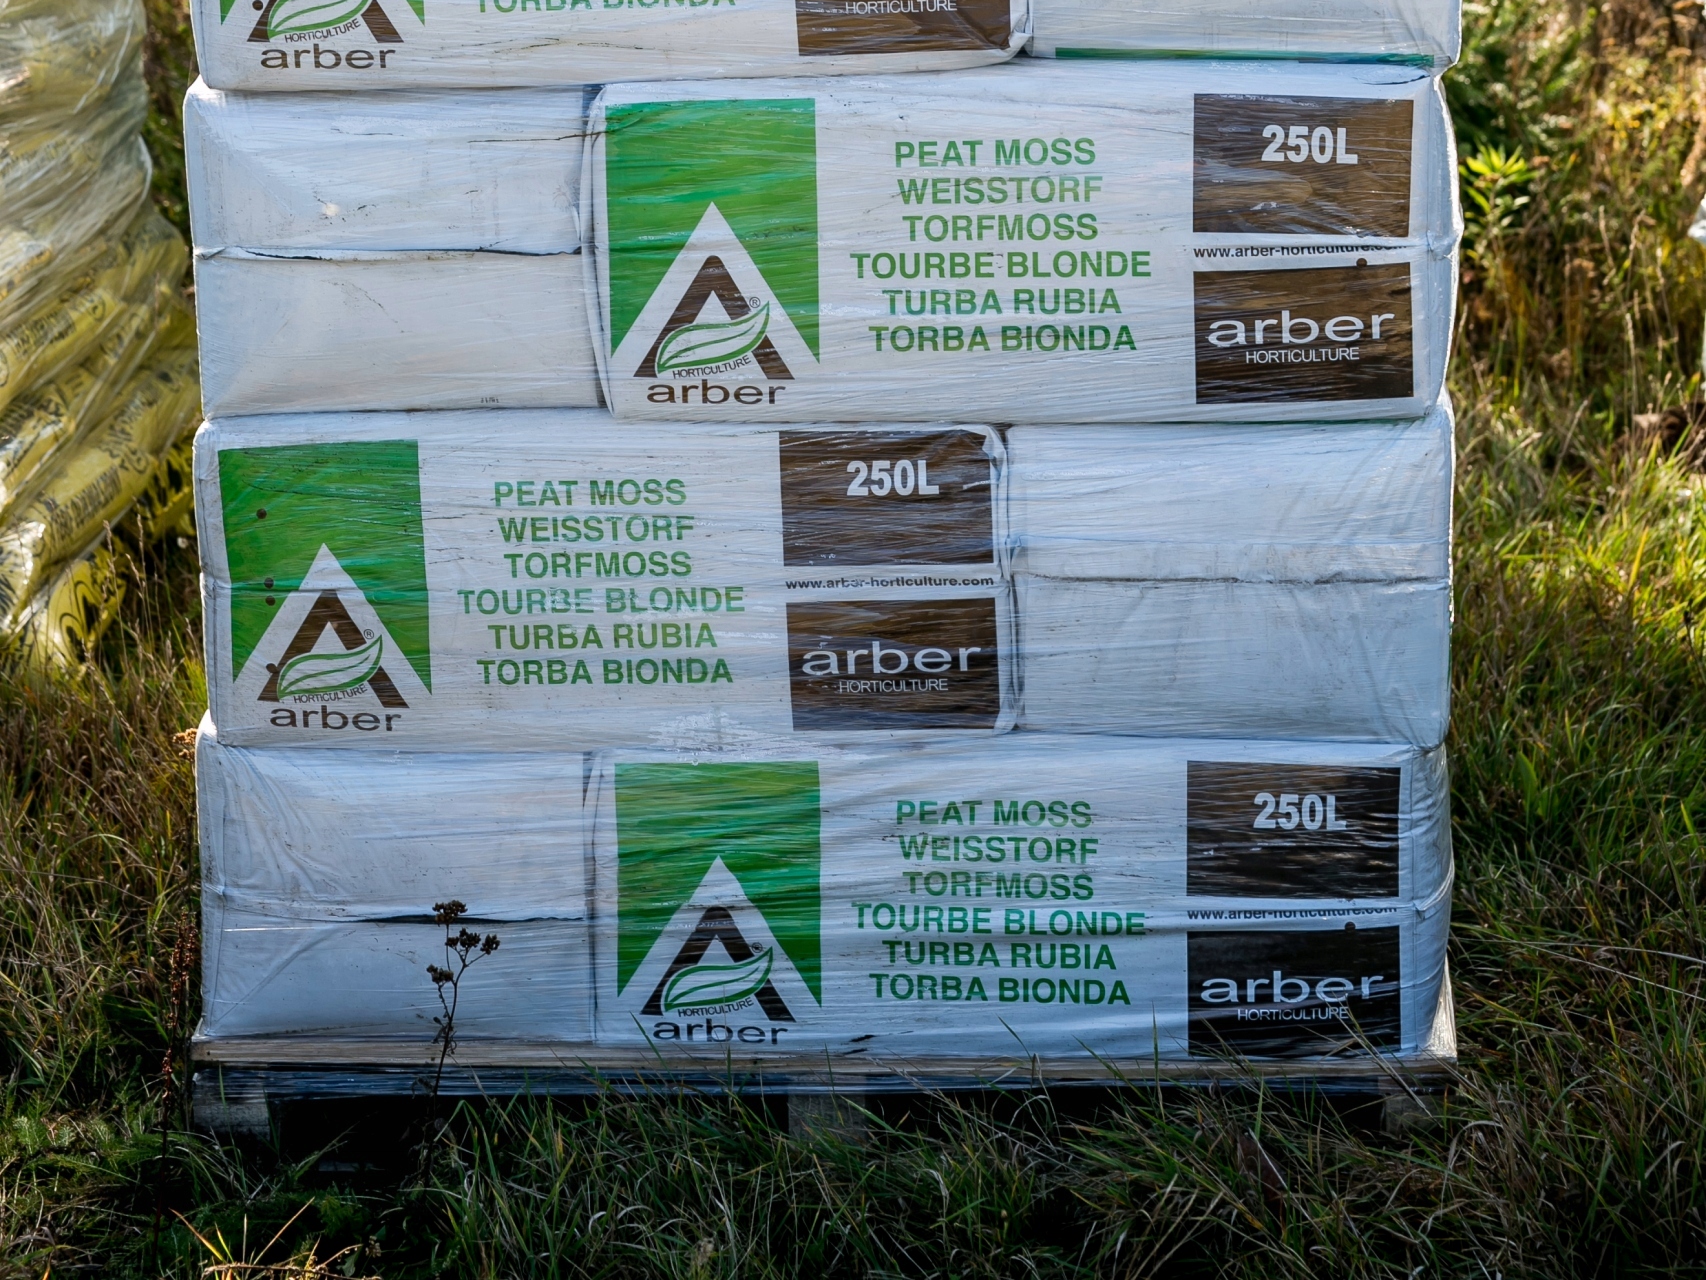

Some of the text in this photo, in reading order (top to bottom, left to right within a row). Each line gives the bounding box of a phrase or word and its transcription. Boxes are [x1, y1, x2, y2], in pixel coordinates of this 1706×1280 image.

[284, 18, 361, 44] HORTICULTURE
[260, 44, 395, 69] arber
[896, 137, 1096, 168] PEAT MOSS
[1261, 124, 1358, 164] 250L
[898, 176, 1103, 205] WEISSTORF
[902, 214, 1098, 242] TORFMOSS
[850, 250, 1152, 279] TOURBE BLONDE
[882, 288, 1122, 315] TURBA RUBIA
[868, 324, 1137, 352] TORBA BIONDA
[1208, 310, 1395, 347] arber
[672, 354, 752, 380] HORTICULTURE
[1245, 347, 1359, 364] HORTICULTURE
[647, 380, 785, 405] arber
[846, 459, 939, 496] 250L
[494, 478, 687, 508] PEAT MOSS
[498, 515, 695, 543] WEISSTORF
[504, 551, 691, 579] TORFMOSS
[785, 576, 994, 589] www.arber-horticulture.com
[457, 586, 745, 615] TOURBE BLONDE
[487, 622, 717, 650] TURBA RUBIA
[477, 658, 733, 685] TORBA BIONDA
[802, 641, 981, 676] arber
[293, 683, 367, 705] HORTICULTURE
[839, 678, 948, 693] HORTICULTURE
[270, 705, 402, 732] arber
[897, 800, 1092, 828] PEAT MOSS
[1253, 792, 1346, 830] 250L
[898, 835, 1099, 865] WEISSTORF
[902, 871, 1093, 900] TORFMOSS
[851, 903, 1146, 937] TOURBE BLONDE
[882, 940, 1117, 970] TURBA RUBIA
[869, 974, 1131, 1006] TORBA BIONDA
[1200, 970, 1383, 1004] arber
[678, 996, 754, 1018] HORTICULTURE
[1238, 1007, 1349, 1022] HORTICULTURE
[653, 1018, 788, 1045] arber
